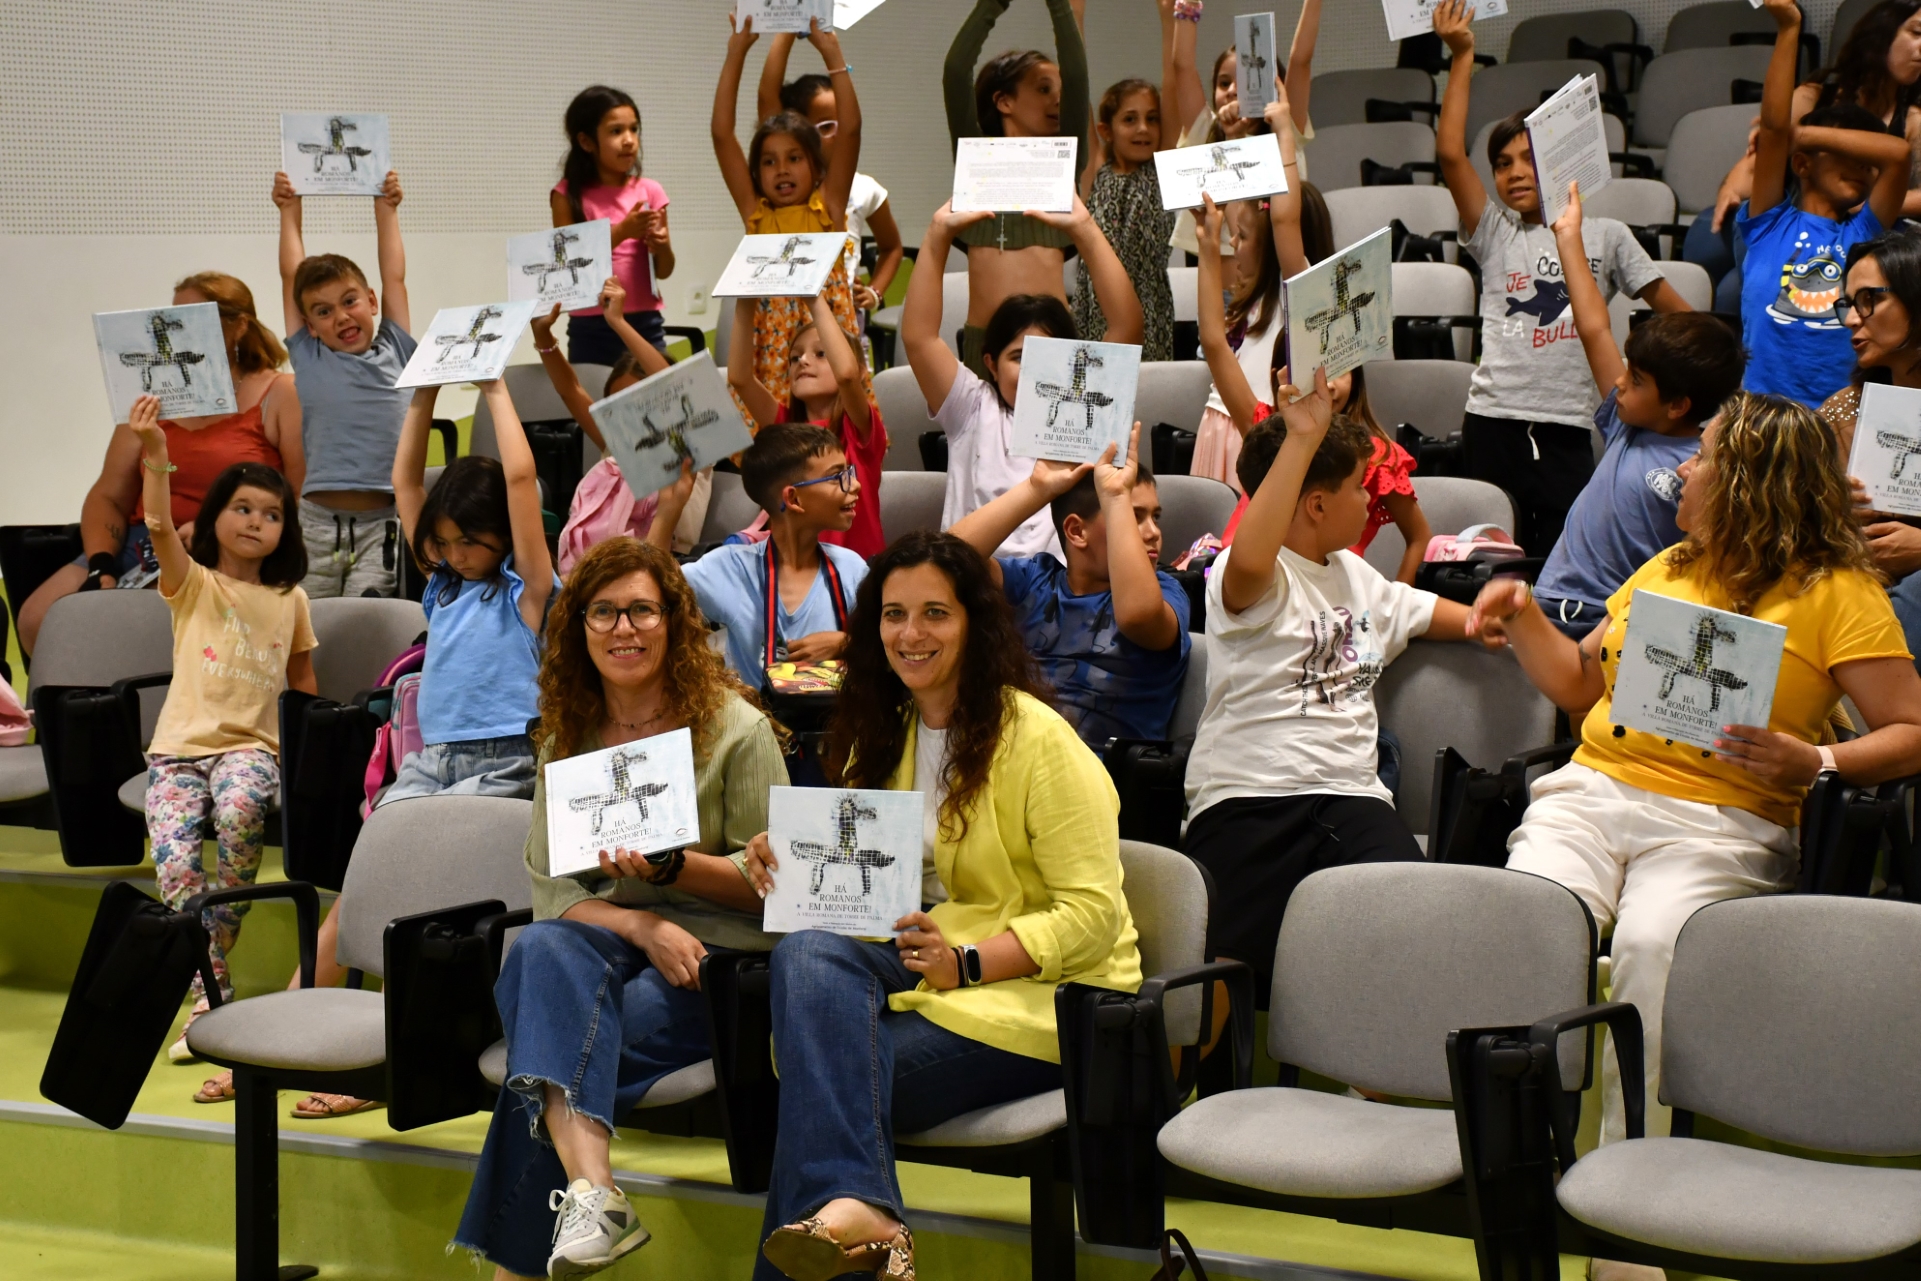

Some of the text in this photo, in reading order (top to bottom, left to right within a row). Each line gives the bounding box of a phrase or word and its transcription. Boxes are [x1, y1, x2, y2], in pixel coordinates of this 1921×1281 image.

[1537, 256, 1602, 276] COE
[1506, 272, 1531, 293] JE
[1502, 320, 1524, 338] LA
[1533, 320, 1578, 348] BULL
[1053, 426, 1084, 435] ROMANOS
[1056, 434, 1092, 444] MONFORTE!
[1683, 695, 1695, 705] HÁ
[1666, 700, 1708, 717] ROMANOS
[1655, 706, 1718, 729] EM MONFORTE!
[601, 823, 641, 838] ROMANOS
[614, 819, 626, 827] HÁ
[606, 828, 652, 844] MONFORTE!
[835, 883, 847, 893] HÁ
[820, 894, 862, 903] ROMANOS
[824, 904, 871, 913] MONFORTE!
